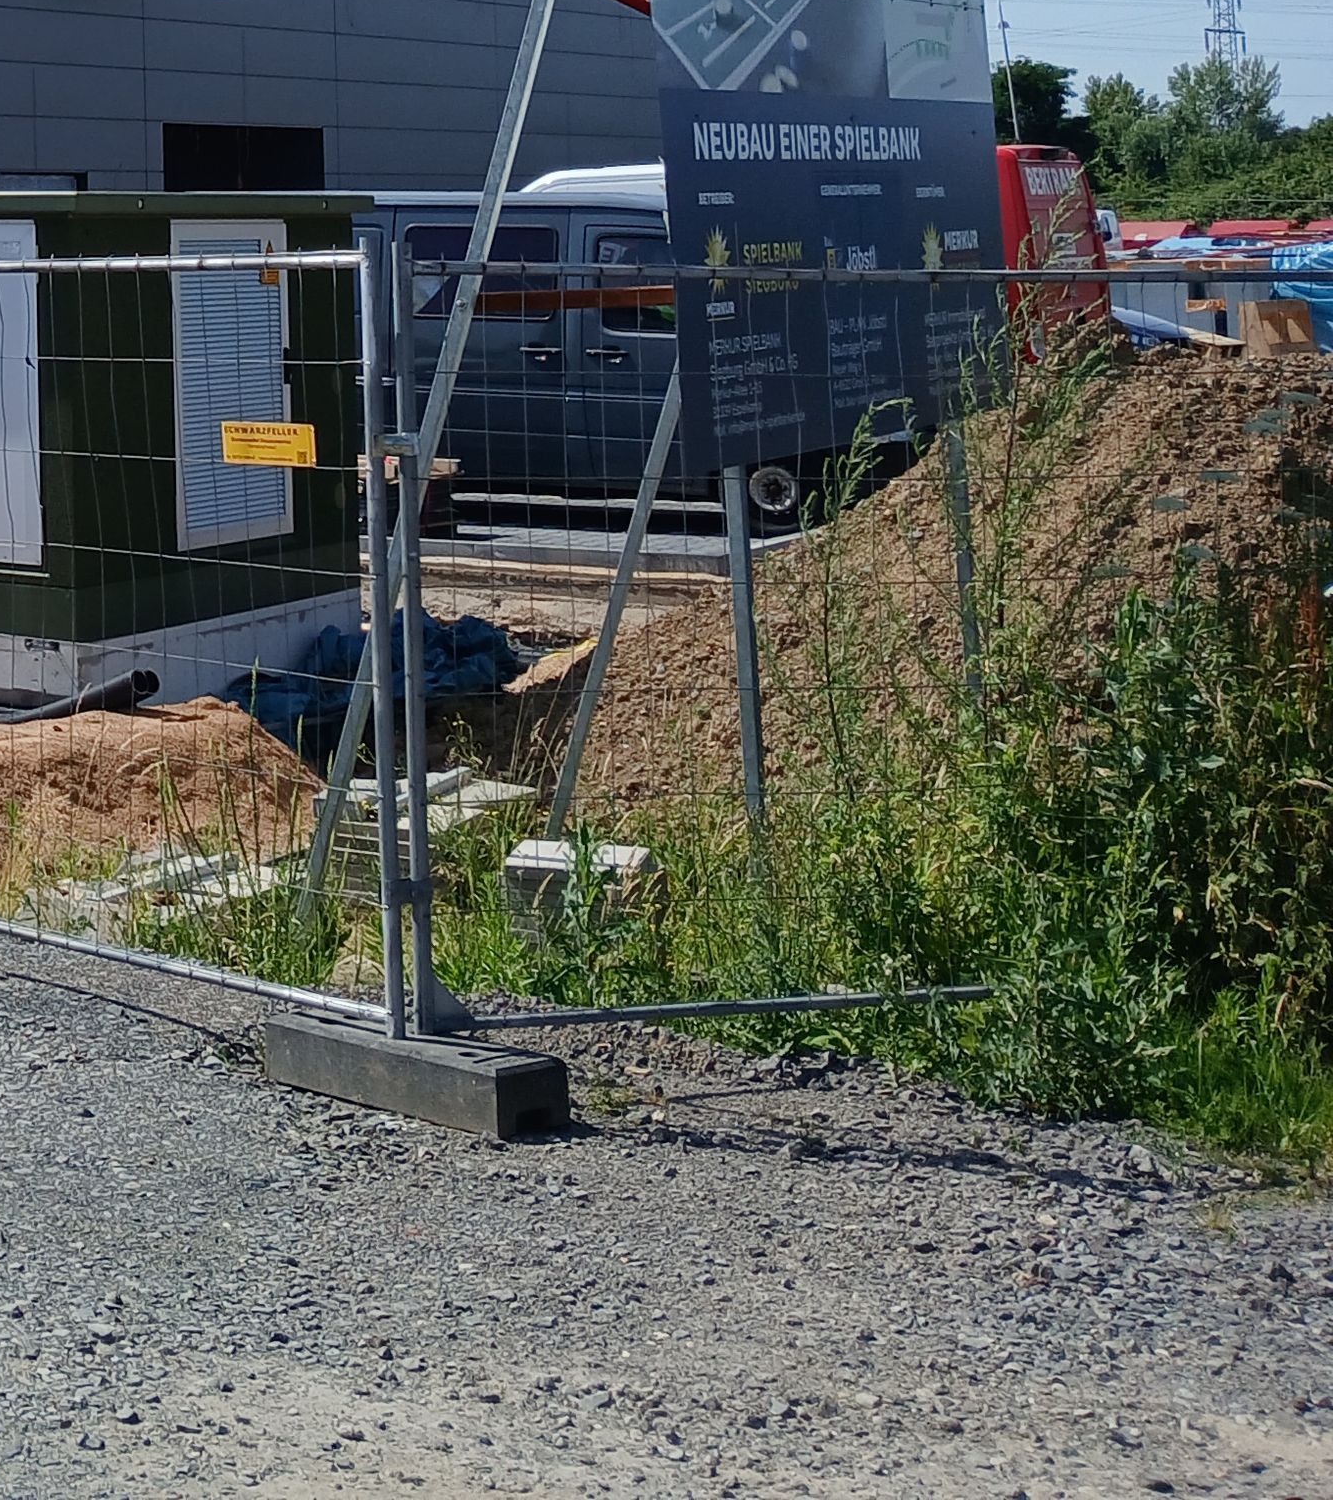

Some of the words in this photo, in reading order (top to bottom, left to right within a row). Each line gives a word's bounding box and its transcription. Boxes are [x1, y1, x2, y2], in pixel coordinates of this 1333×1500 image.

[693, 122, 775, 161] NEUBAU
[780, 124, 832, 161] EINER
[835, 125, 921, 161] SPIELBANK
[944, 230, 979, 251] MERKUR
[743, 241, 803, 265] SPIELBANK
